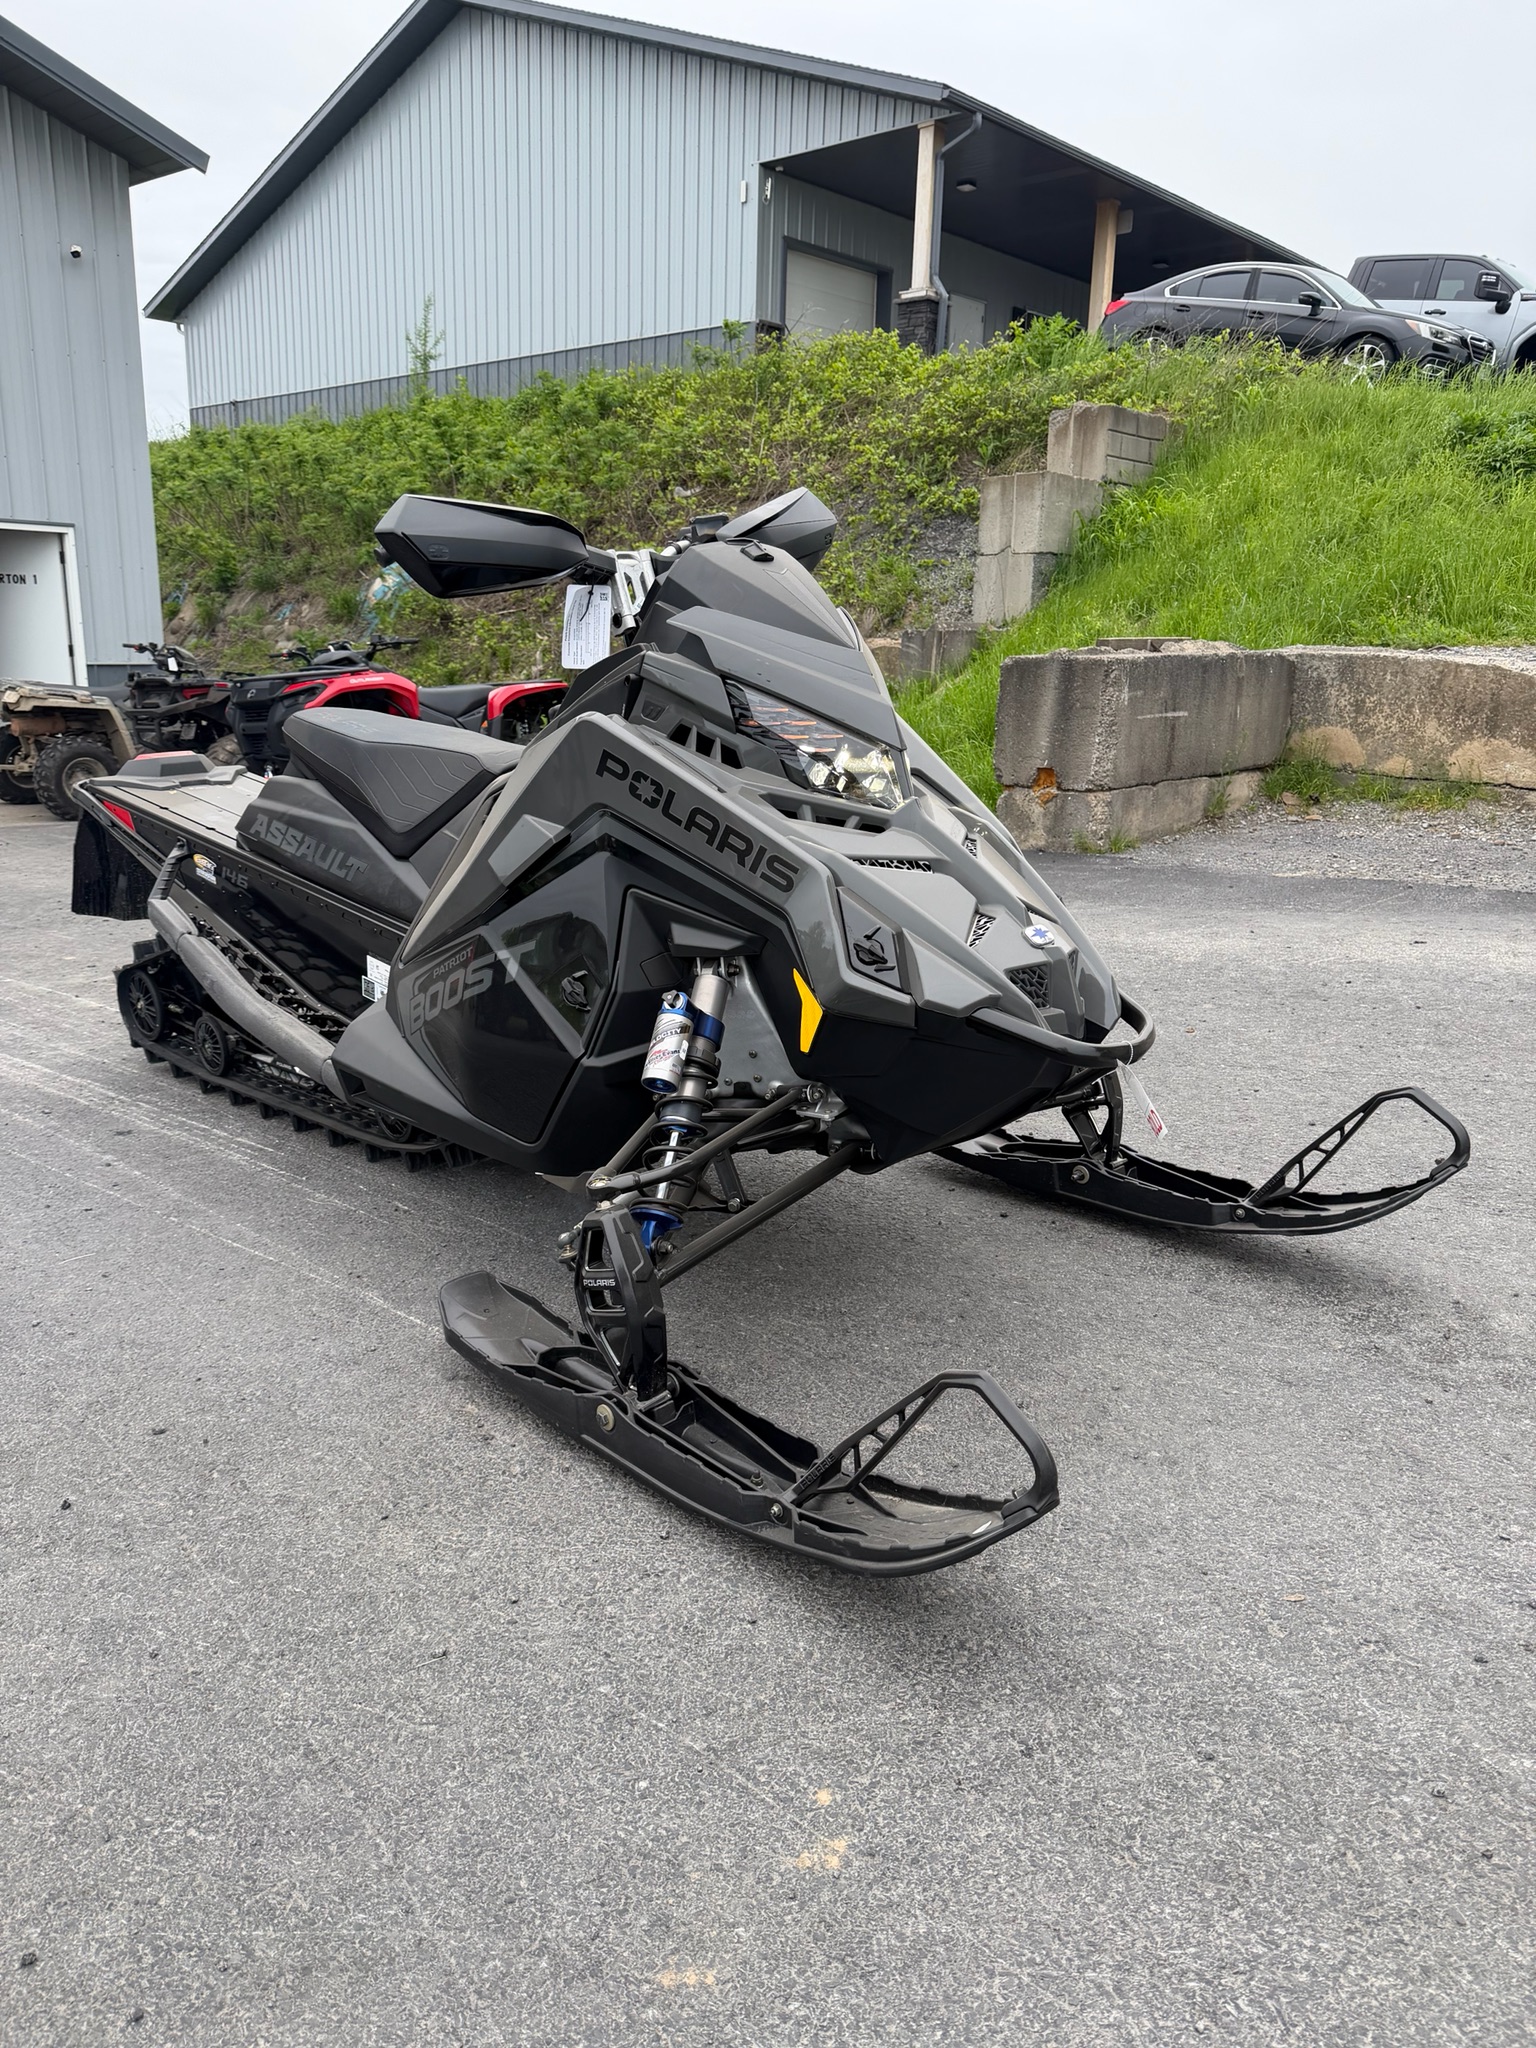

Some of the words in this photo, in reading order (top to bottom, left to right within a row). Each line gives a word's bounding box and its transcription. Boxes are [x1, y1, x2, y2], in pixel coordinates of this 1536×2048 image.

[33, 574, 38, 585] 1
[595, 749, 800, 893] POLARIS
[249, 813, 369, 882] ASSAULT
[221, 866, 249, 890] 146
[433, 946, 474, 979] PATRIOT
[410, 940, 537, 1035] BOOST
[583, 1279, 616, 1287] POLARIS
[800, 1453, 836, 1490] POLARIS
